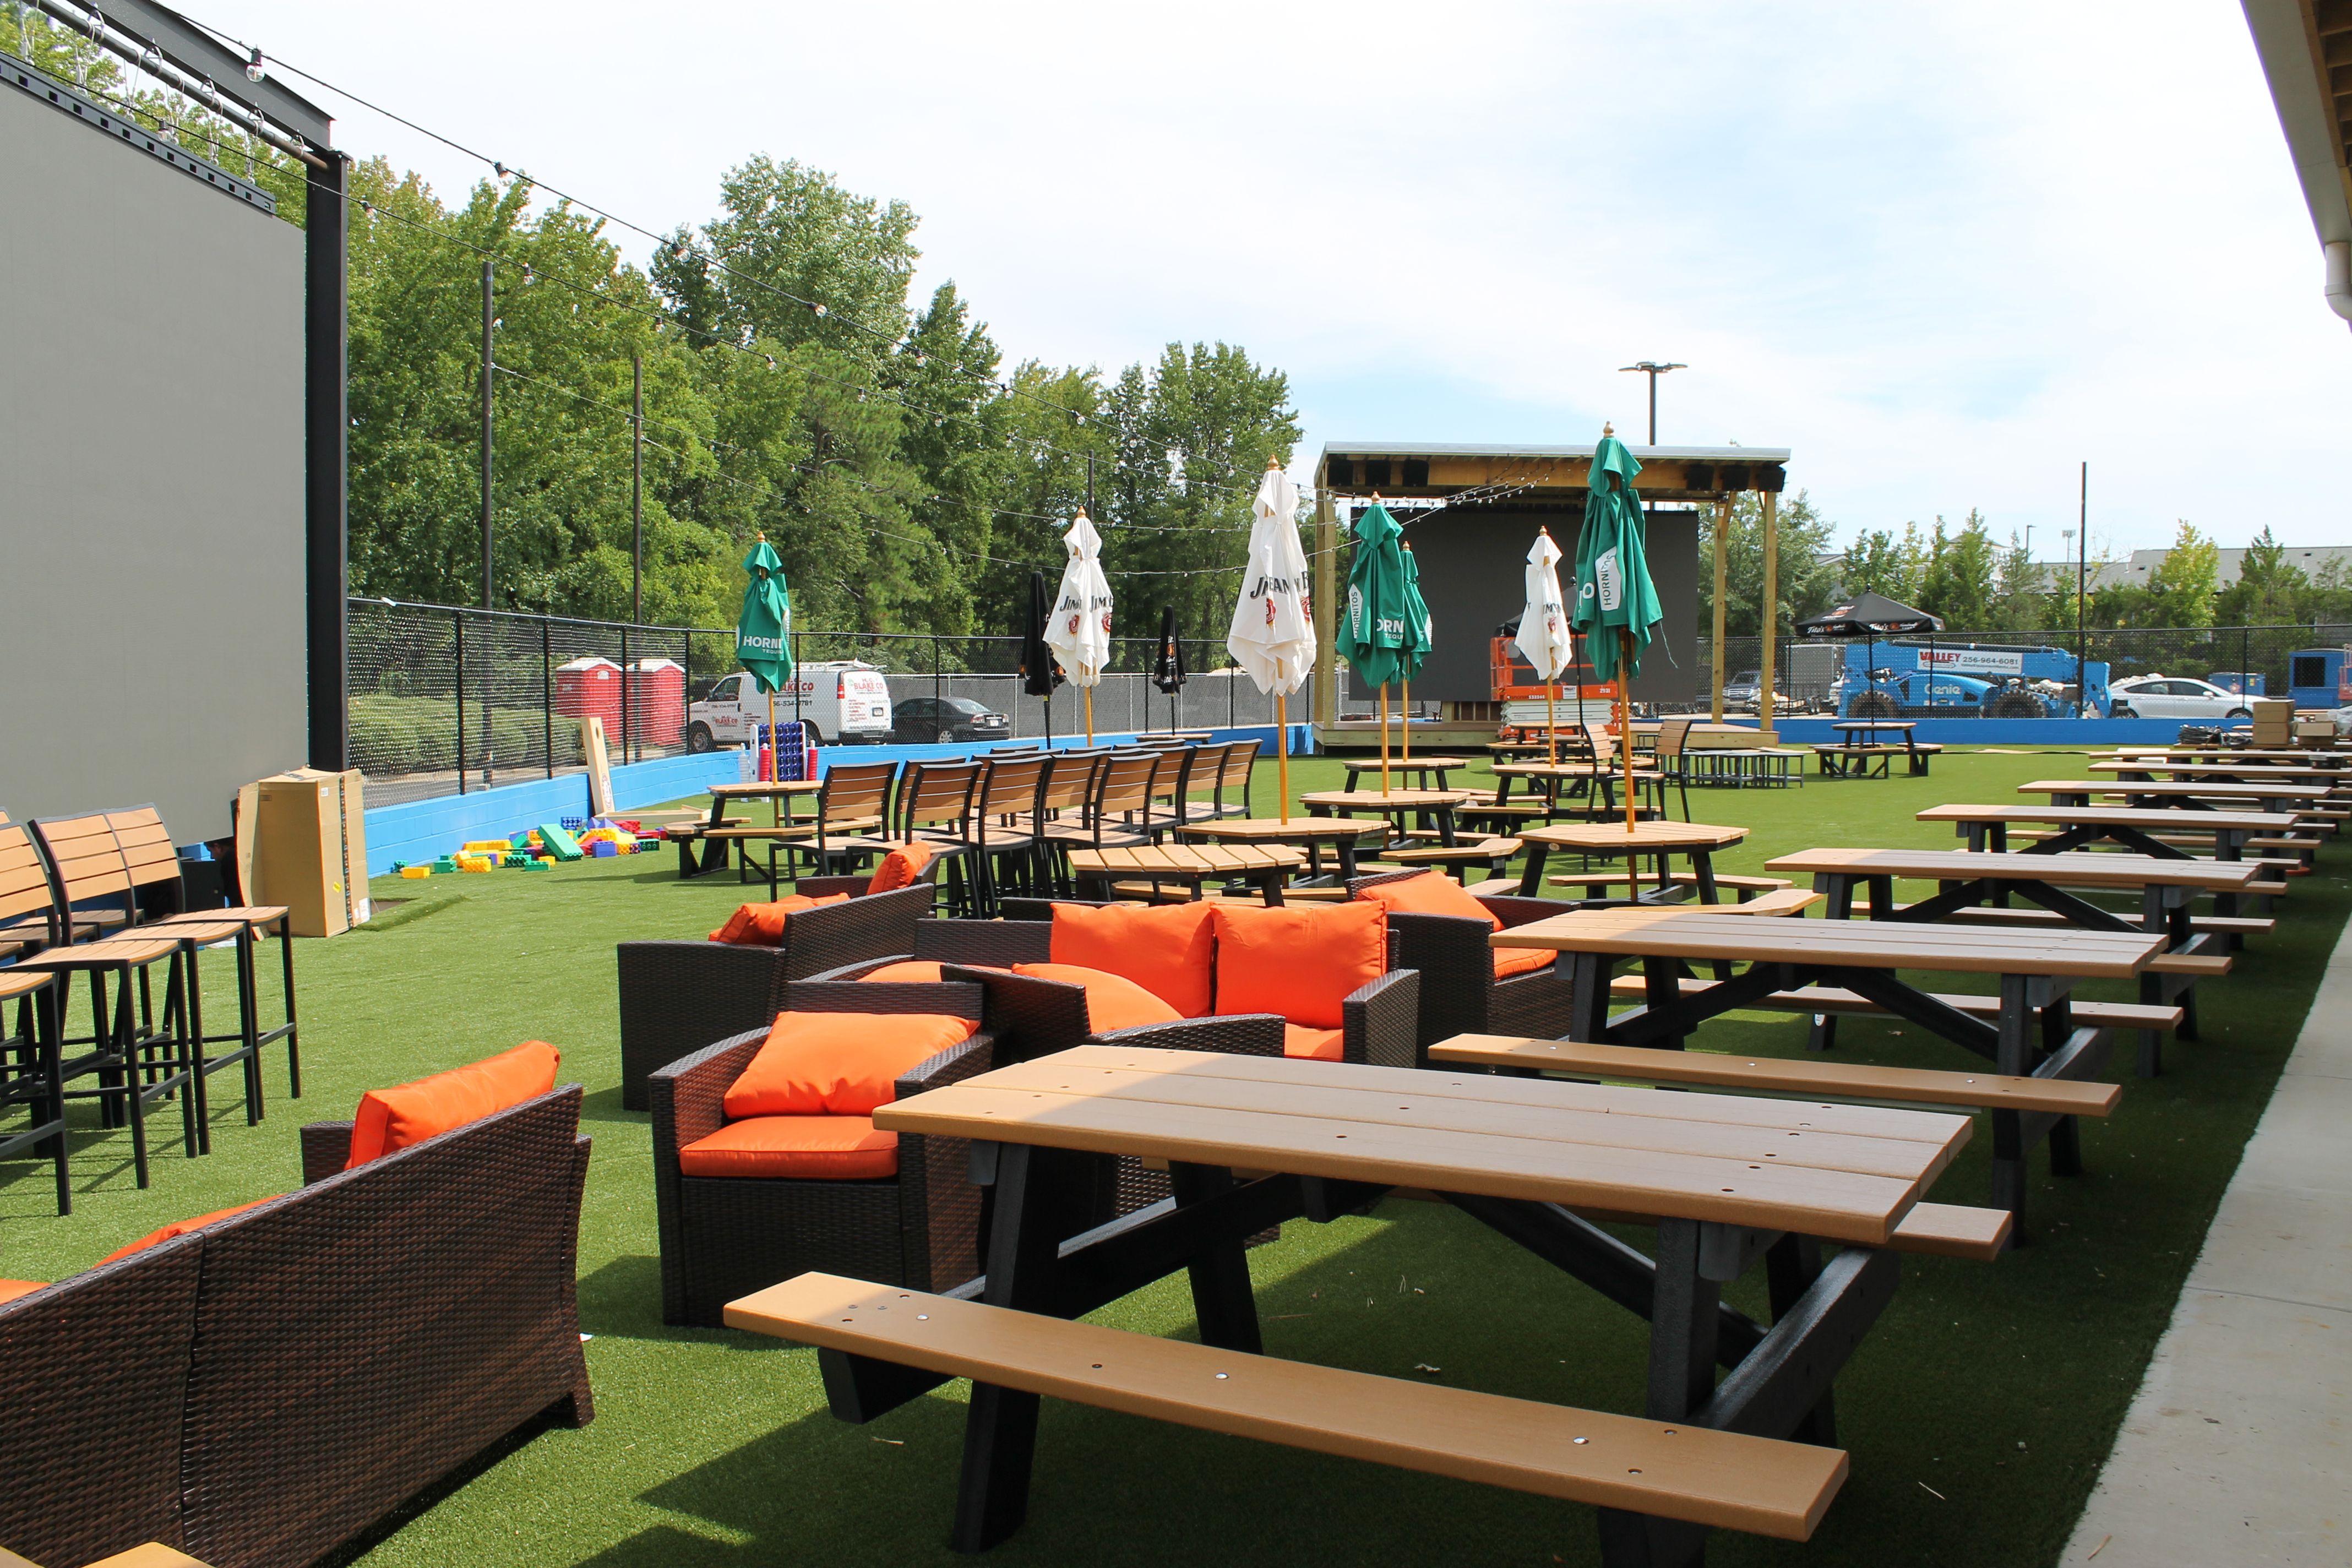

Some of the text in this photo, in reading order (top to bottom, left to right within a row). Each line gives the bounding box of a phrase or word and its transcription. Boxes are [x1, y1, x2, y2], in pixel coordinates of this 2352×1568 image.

[1807, 625, 1825, 634] Tito's
[1869, 623, 1889, 631] Tito's
[743, 636, 782, 649] HORNI
[1920, 651, 1962, 662] VALLEY
[1962, 656, 2019, 665] 256-964-6081
[1924, 684, 1961, 695] Genie
